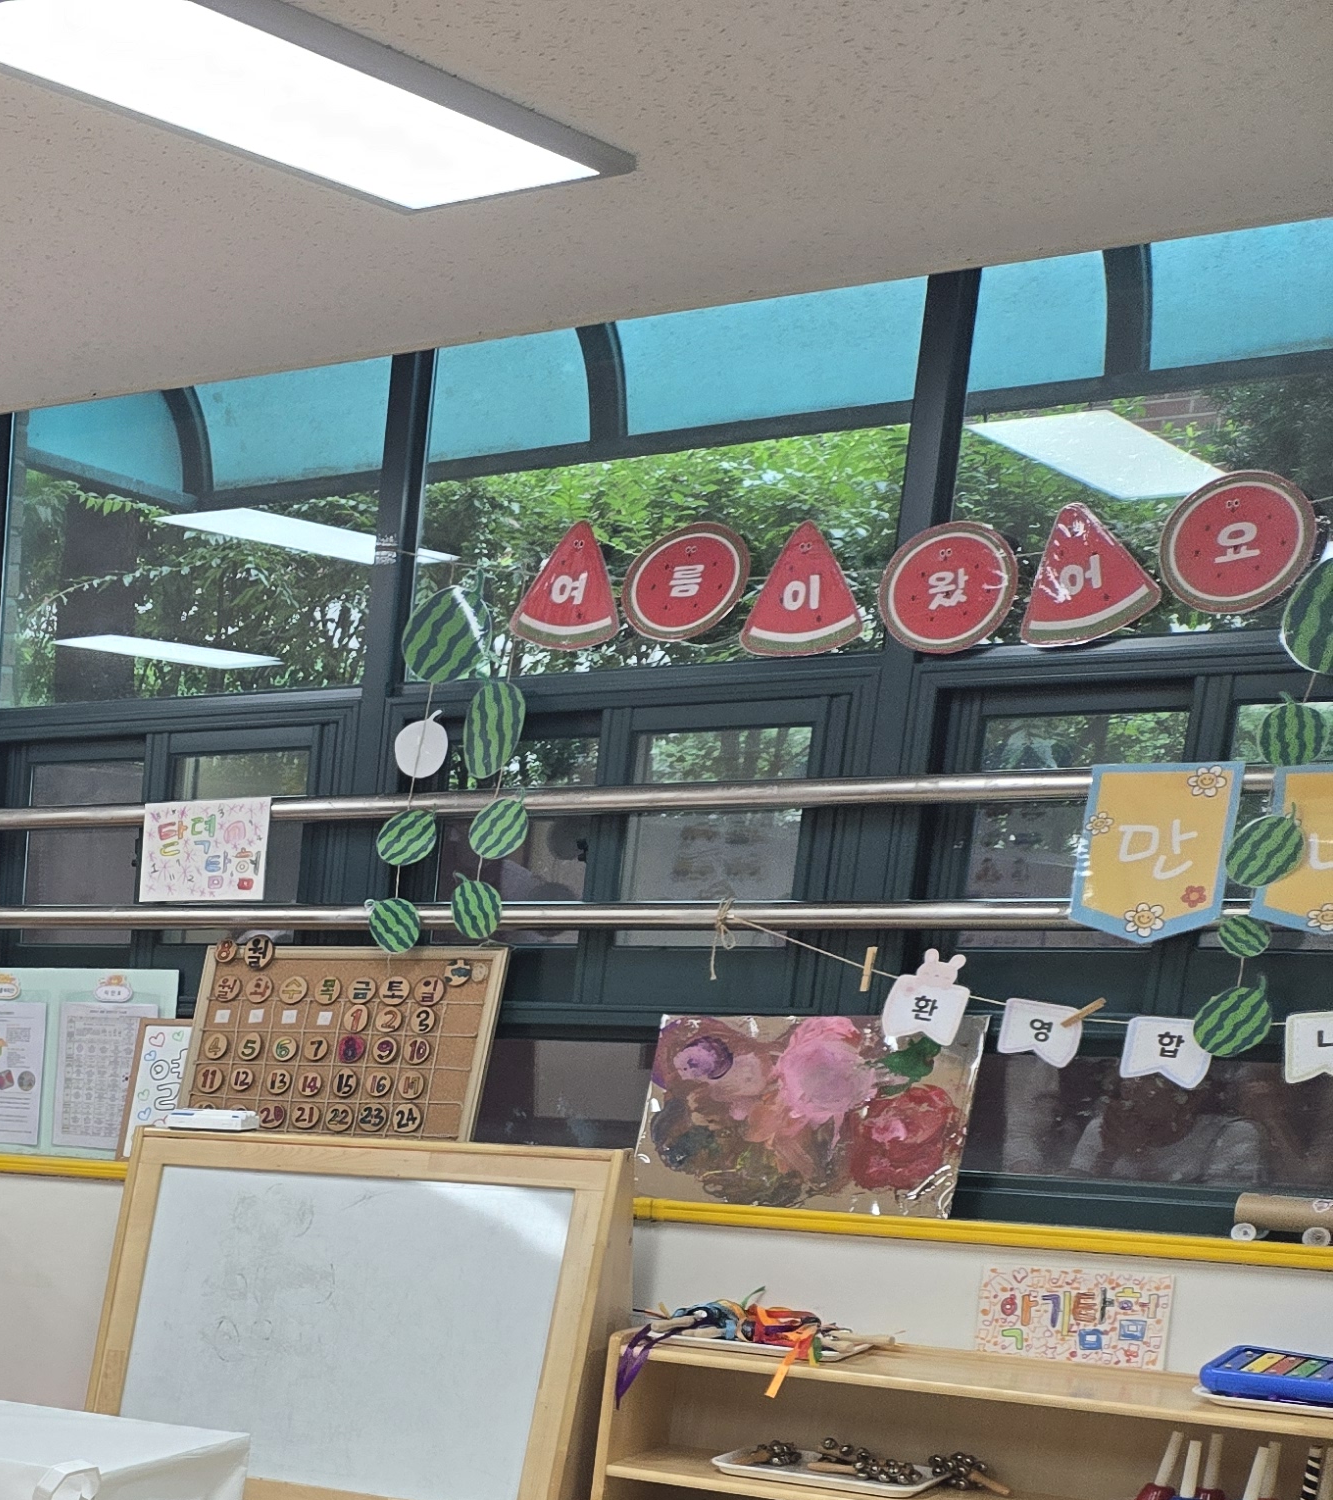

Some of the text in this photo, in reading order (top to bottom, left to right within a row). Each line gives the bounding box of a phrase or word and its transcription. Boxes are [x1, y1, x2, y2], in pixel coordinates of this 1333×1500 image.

[282, 978, 302, 999] 수
[320, 979, 335, 1001] 목
[352, 980, 372, 1000] 금
[383, 980, 404, 999] 토
[421, 980, 438, 1003] 일
[351, 1008, 362, 1030] 1
[380, 1011, 397, 1030] 2
[242, 1040, 257, 1056] 5
[275, 1039, 290, 1058] 6
[310, 1040, 323, 1057] 7
[377, 1039, 394, 1060] 9
[200, 1069, 219, 1088] 11
[234, 1070, 249, 1087] 12
[270, 1072, 287, 1090] 13
[301, 1074, 318, 1092] 14
[337, 1073, 354, 1094] 15
[370, 1074, 386, 1092] 16
[295, 1106, 314, 1122] 21
[328, 1109, 351, 1126] 22
[359, 1107, 384, 1125] 23
[396, 1109, 417, 1128] 24
